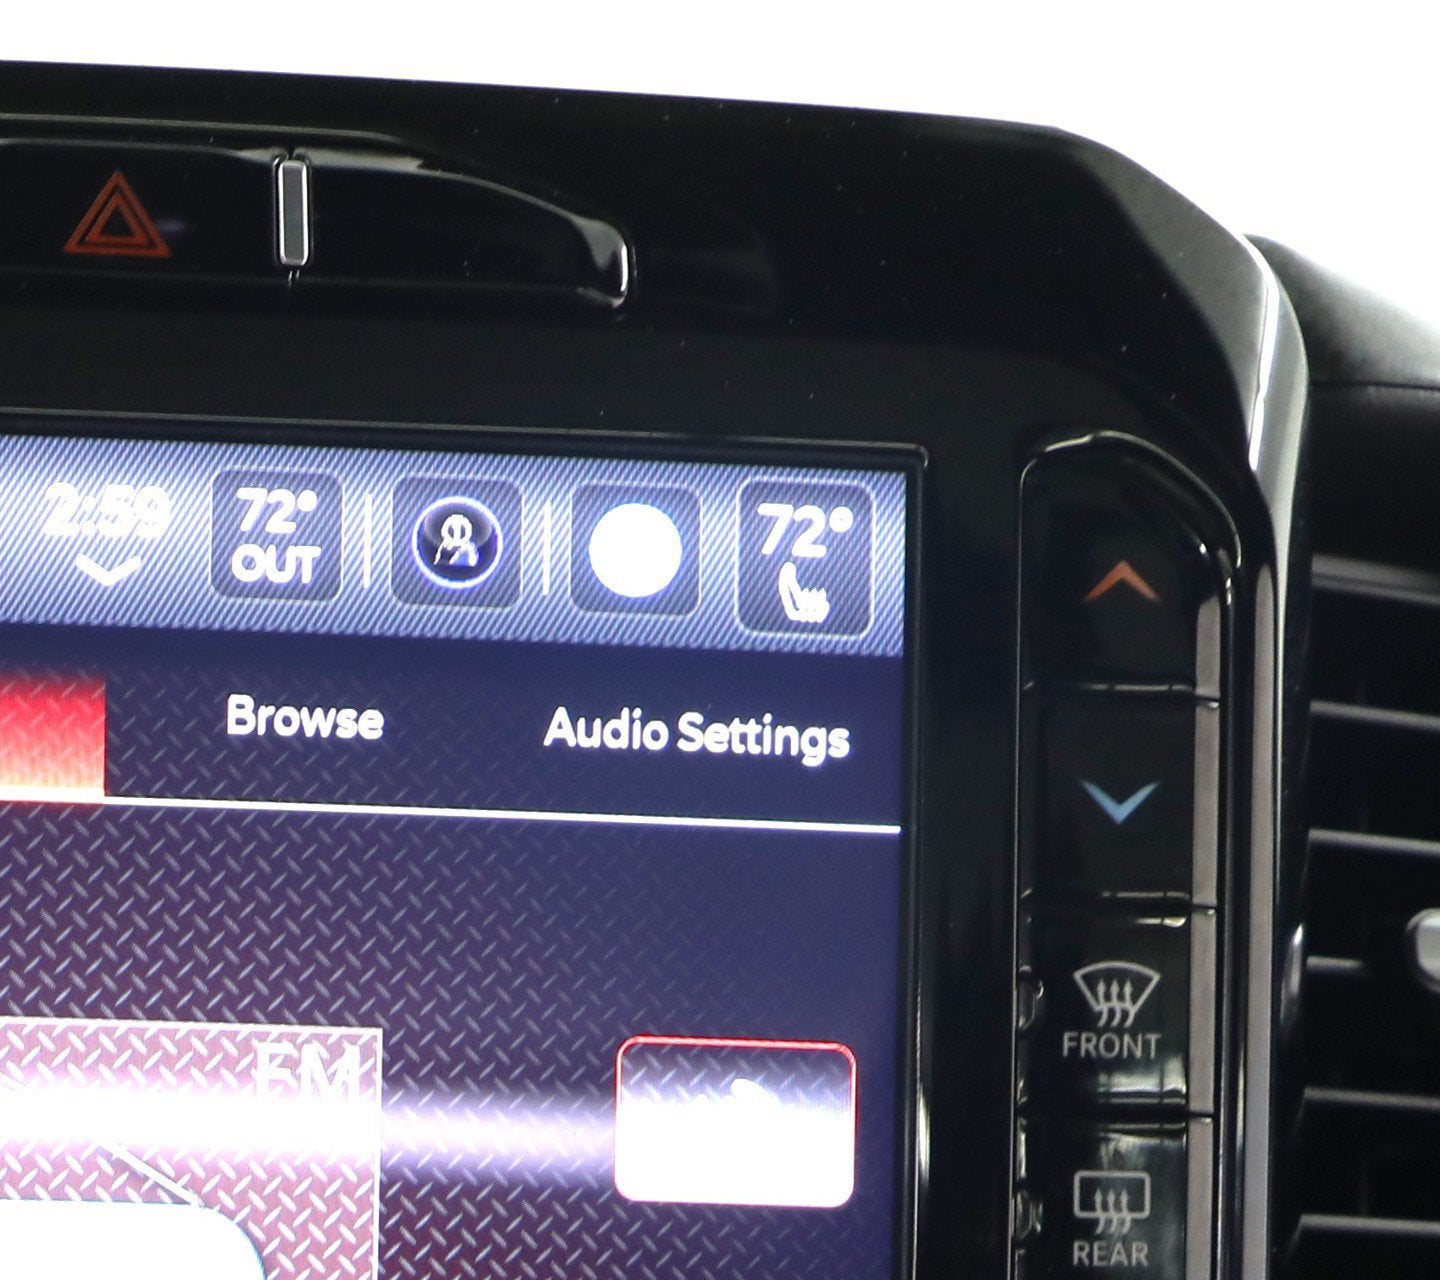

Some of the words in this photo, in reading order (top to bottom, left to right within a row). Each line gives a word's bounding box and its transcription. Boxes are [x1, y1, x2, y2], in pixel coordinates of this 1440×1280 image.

[42, 481, 172, 539] 2:59
[235, 486, 320, 535] 72°
[756, 502, 855, 558] 72°
[231, 543, 322, 584] OUT
[226, 693, 386, 742] Browse
[543, 706, 669, 754] Audio
[677, 711, 851, 769] Settings
[1062, 1031, 1162, 1060] FRONT
[1072, 1240, 1150, 1268] REAR
